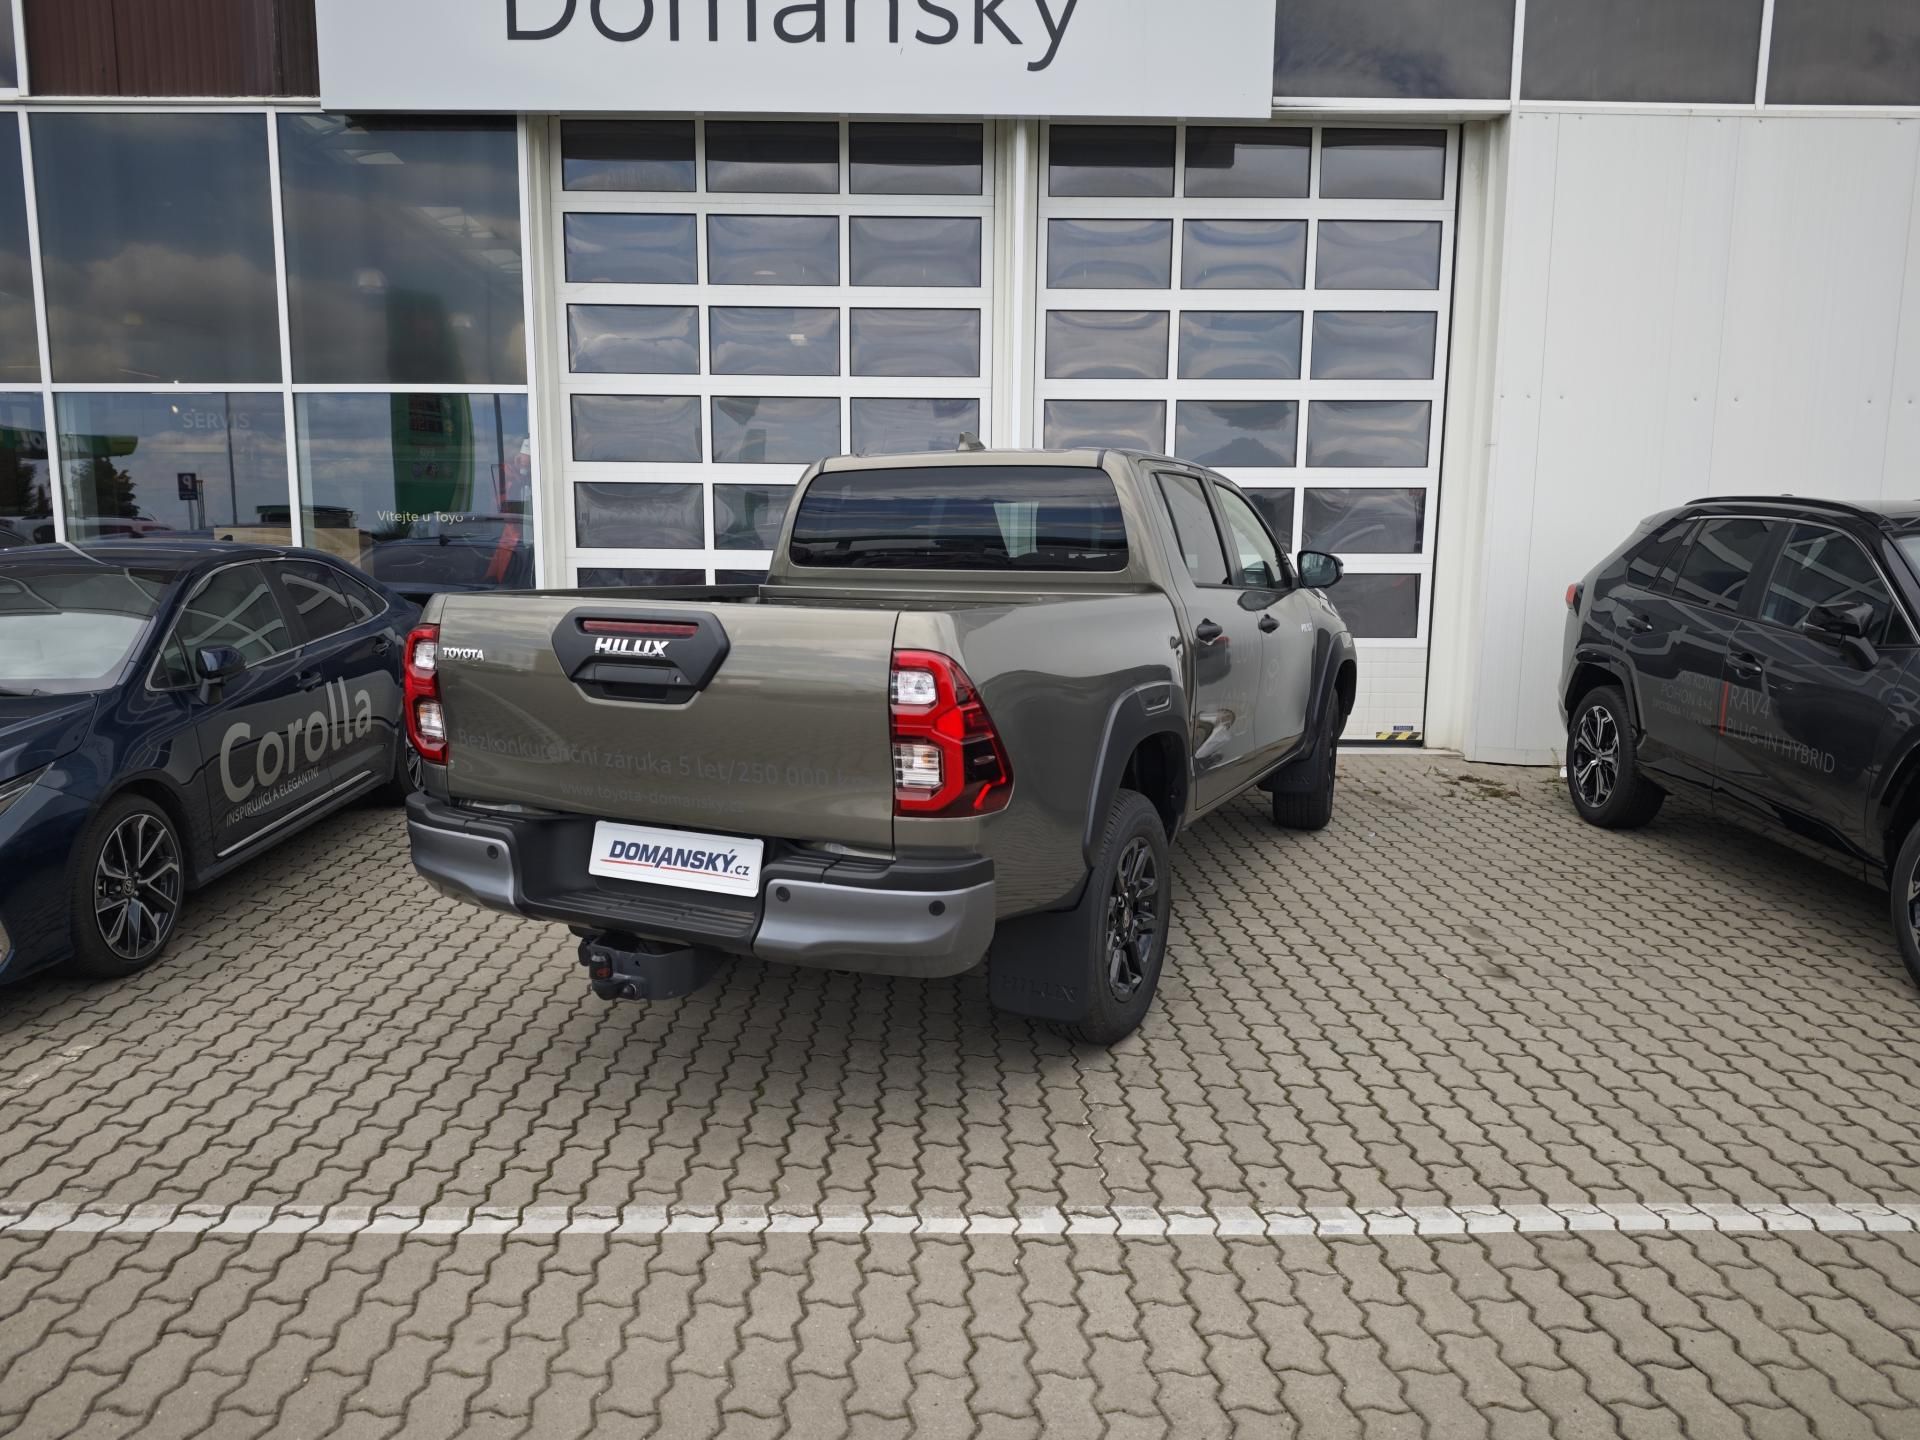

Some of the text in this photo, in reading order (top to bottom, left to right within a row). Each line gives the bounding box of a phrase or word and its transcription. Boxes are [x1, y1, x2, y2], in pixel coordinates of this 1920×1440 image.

[182, 412, 250, 429] SERVIS
[422, 513, 431, 522] u
[434, 511, 475, 525] Toyo
[442, 647, 485, 662] TOYOTA
[594, 637, 670, 657] HILUX
[1729, 685, 1771, 719] RAV4
[220, 676, 372, 803] Corolla
[1725, 718, 1835, 774] PLUG-IN HYBRID
[457, 728, 598, 766] Bezkonkurenční
[604, 750, 672, 775] záruka
[679, 755, 691, 777] 5
[696, 756, 779, 785] let/250
[785, 766, 829, 786] 000
[273, 787, 280, 801] A
